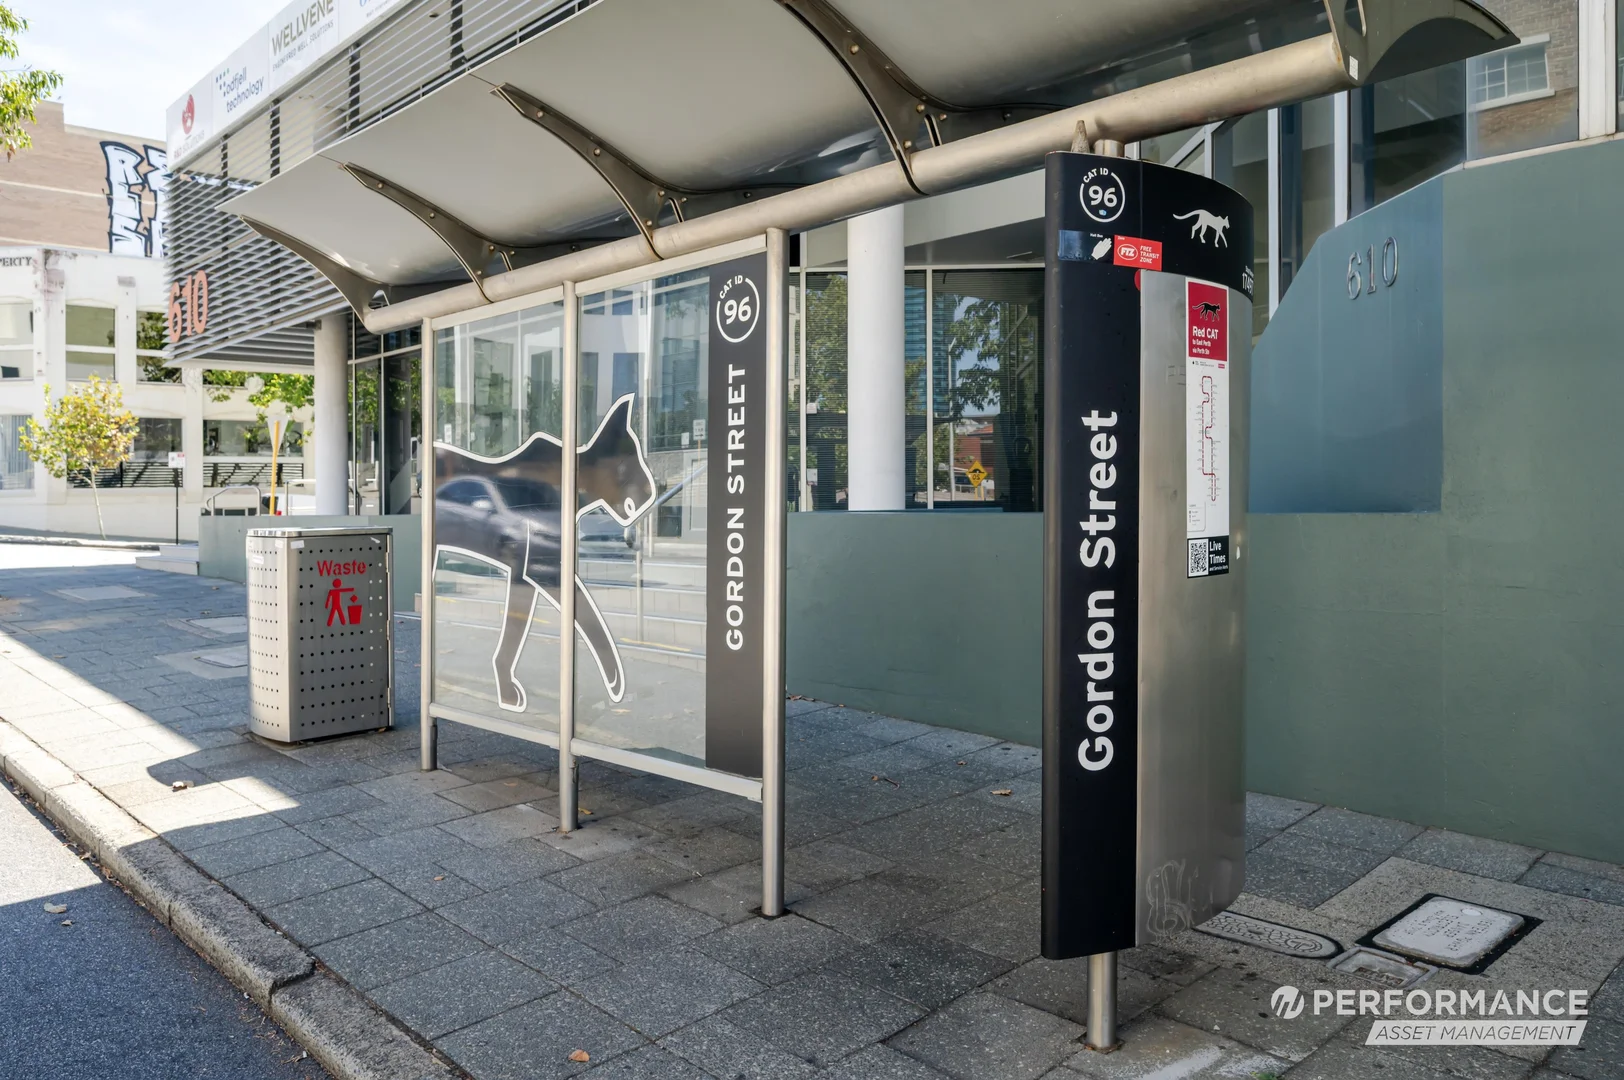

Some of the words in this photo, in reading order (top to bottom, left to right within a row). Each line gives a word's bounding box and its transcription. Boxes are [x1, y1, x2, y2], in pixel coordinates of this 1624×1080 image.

[272, 0, 334, 56] WELLVENE
[226, 66, 247, 94] odfjell
[226, 76, 264, 113] technology
[1083, 168, 1097, 183] CAT
[1099, 167, 1109, 176] ID
[1088, 185, 1118, 207] 96
[1120, 247, 1135, 257] FTZ
[1140, 251, 1160, 259] TRANSIT
[1347, 236, 1398, 300] 610
[719, 279, 733, 300] CAT
[734, 274, 743, 285] ID
[168, 269, 209, 343] 610
[724, 296, 751, 325] 96
[1192, 326, 1205, 337] Red
[1206, 328, 1219, 339] CAT
[727, 364, 746, 494] STREET
[1079, 409, 1119, 569] Street
[1209, 541, 1222, 552] Live
[1209, 554, 1226, 564] Times
[317, 559, 367, 577] Waste
[726, 508, 745, 650] GORDON
[1077, 589, 1116, 772] Gordon
